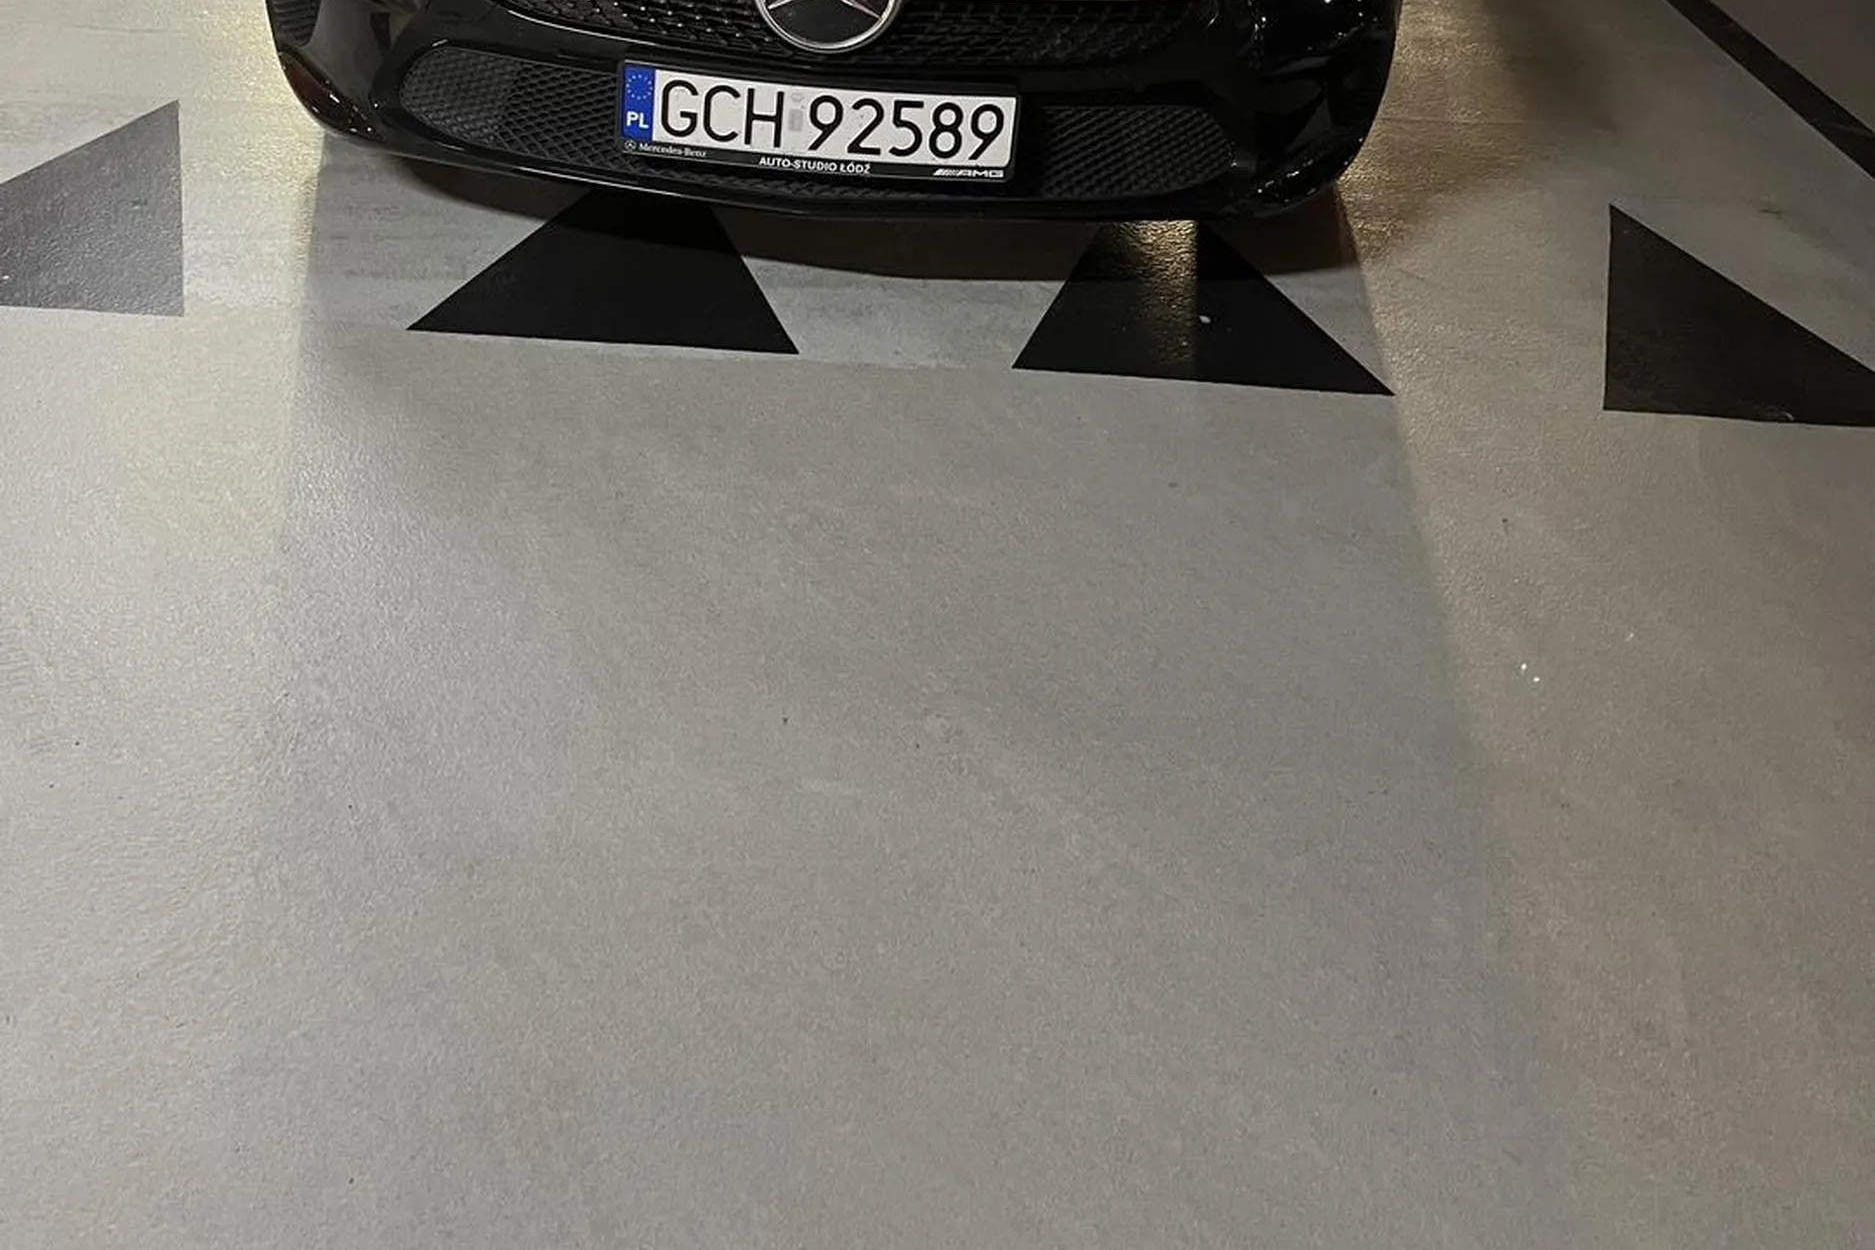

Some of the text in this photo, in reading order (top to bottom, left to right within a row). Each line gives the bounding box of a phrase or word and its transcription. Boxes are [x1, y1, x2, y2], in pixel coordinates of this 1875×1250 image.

[626, 111, 649, 128] PL
[661, 80, 1005, 161] GCH 92589
[639, 142, 706, 157] Mercedes-Benz
[759, 156, 837, 171] AUTO-STUDIO
[956, 169, 1004, 178] AMG
